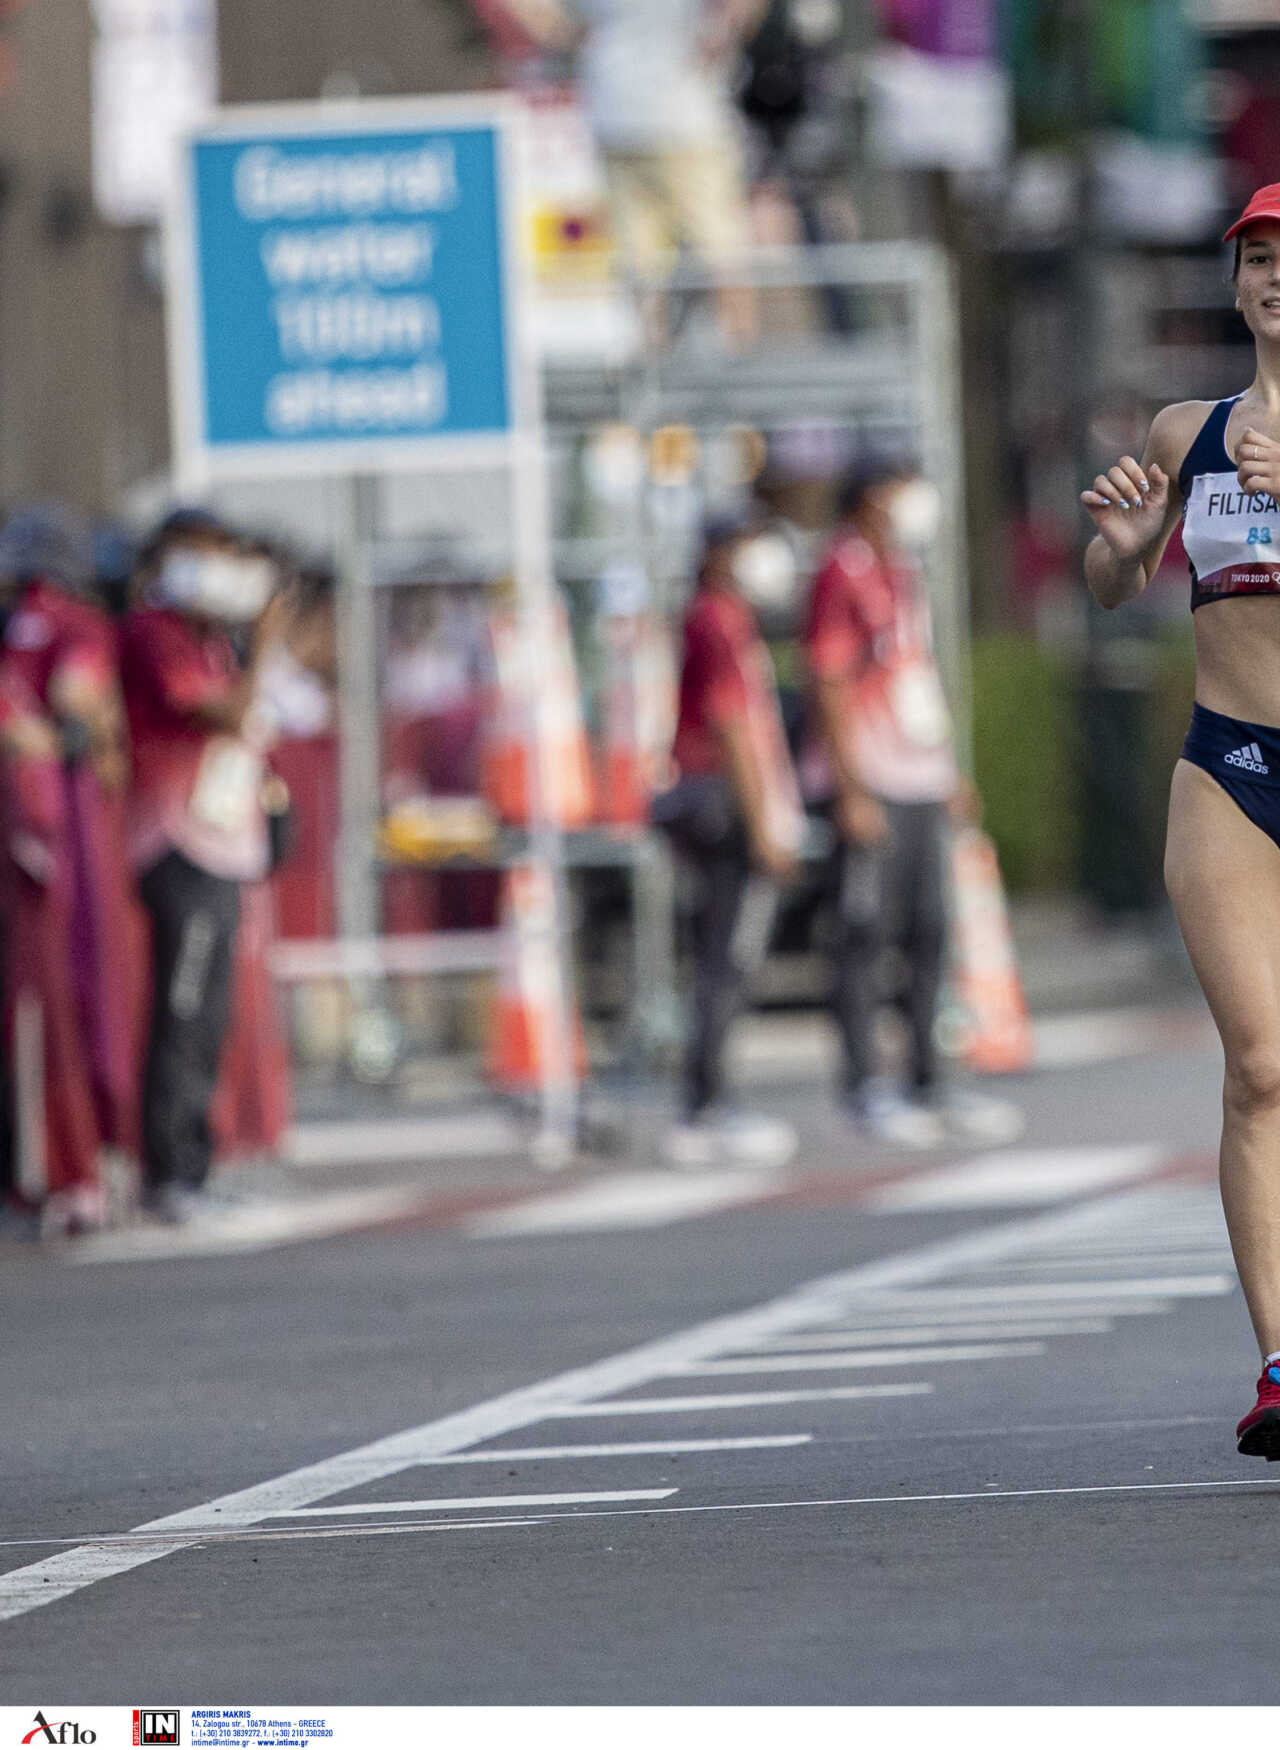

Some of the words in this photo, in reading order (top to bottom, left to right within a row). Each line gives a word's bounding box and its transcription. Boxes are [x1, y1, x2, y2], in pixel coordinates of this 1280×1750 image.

[235, 138, 457, 220] General
[261, 222, 435, 291] water
[264, 357, 447, 434] ahead
[1231, 573, 1250, 583] TOKYO
[1250, 574, 1270, 583] 2020
[1224, 754, 1269, 774] adidas
